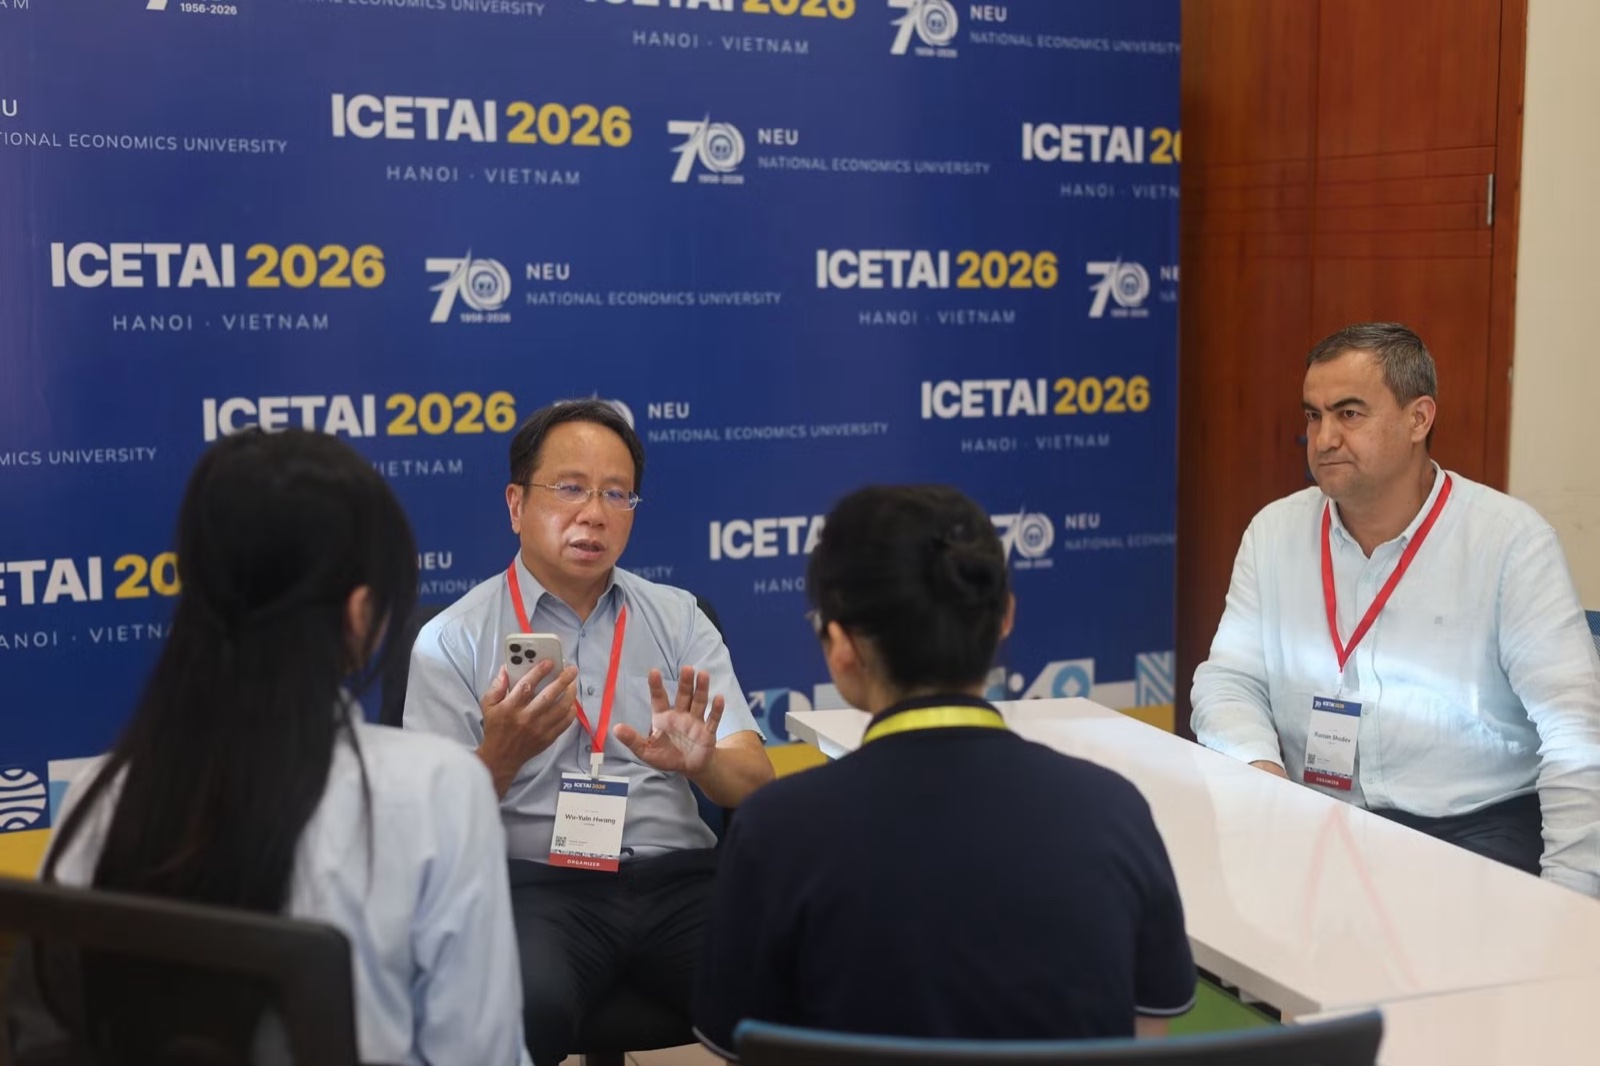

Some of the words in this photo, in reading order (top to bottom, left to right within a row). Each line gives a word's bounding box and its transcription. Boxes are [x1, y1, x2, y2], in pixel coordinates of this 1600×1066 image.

[180, 3, 237, 15] 1956-2026
[451, 0, 545, 15] UNIVERSITY
[970, 5, 1007, 22] NEU
[633, 31, 698, 48] HANOI
[722, 36, 808, 54] VIETNAM
[970, 31, 1033, 47] NATIONAL
[1037, 34, 1109, 51] ECONOMICS
[332, 94, 497, 142] ICETAI
[506, 101, 632, 147] 2026
[0, 132, 61, 146] IONAL
[69, 134, 177, 150] ECONOMICS
[184, 138, 287, 153] UNIVERSITY
[758, 128, 798, 145] NEU
[1022, 123, 1144, 163] ICETAI
[667, 113, 745, 183] 70
[758, 156, 828, 170] NATIONAL
[832, 158, 910, 172] ECONOMICS
[914, 161, 990, 174] UNIVERSITY
[387, 166, 457, 182] HANOI
[485, 168, 579, 184] VIETNAM
[1060, 184, 1114, 197] HANOI
[1133, 184, 1180, 199] VIETN
[51, 242, 235, 287] ICETAI
[246, 244, 385, 288] 2026
[526, 263, 569, 280] NEU
[817, 249, 949, 288] ICETAI
[956, 250, 1058, 288] 2026
[425, 247, 511, 323] 70
[526, 291, 602, 305] NATIONAL
[608, 291, 695, 305] ECONOMICS
[699, 291, 781, 305] UNIVERSITY
[113, 315, 192, 331] HANOI
[223, 314, 328, 330] VIETNAM
[859, 310, 916, 325] HANOI
[938, 310, 1015, 325] VIETNAM
[922, 379, 1047, 419] ICETAI
[1054, 376, 1150, 414] 2026
[203, 394, 376, 441] ICETAI
[386, 391, 516, 435] 2026
[648, 402, 689, 419] NEU
[648, 429, 720, 442] NATIONAL
[725, 425, 807, 440] ECONOMICS
[810, 422, 888, 437] UNIVERSITY
[961, 437, 1016, 452] HANOI
[1036, 434, 1109, 449] VIETNAM
[49, 447, 156, 464] UNIVERSITY
[1065, 513, 1100, 529] NEU
[710, 515, 825, 560] ICETA
[0, 557, 102, 606] TAI
[114, 552, 181, 599] 20
[754, 576, 805, 593] HANO
[0, 632, 57, 649] ANOI
[89, 624, 172, 643] VIETN
[592, 816, 616, 825] Hwang
[567, 859, 600, 867] ORGANIZER
